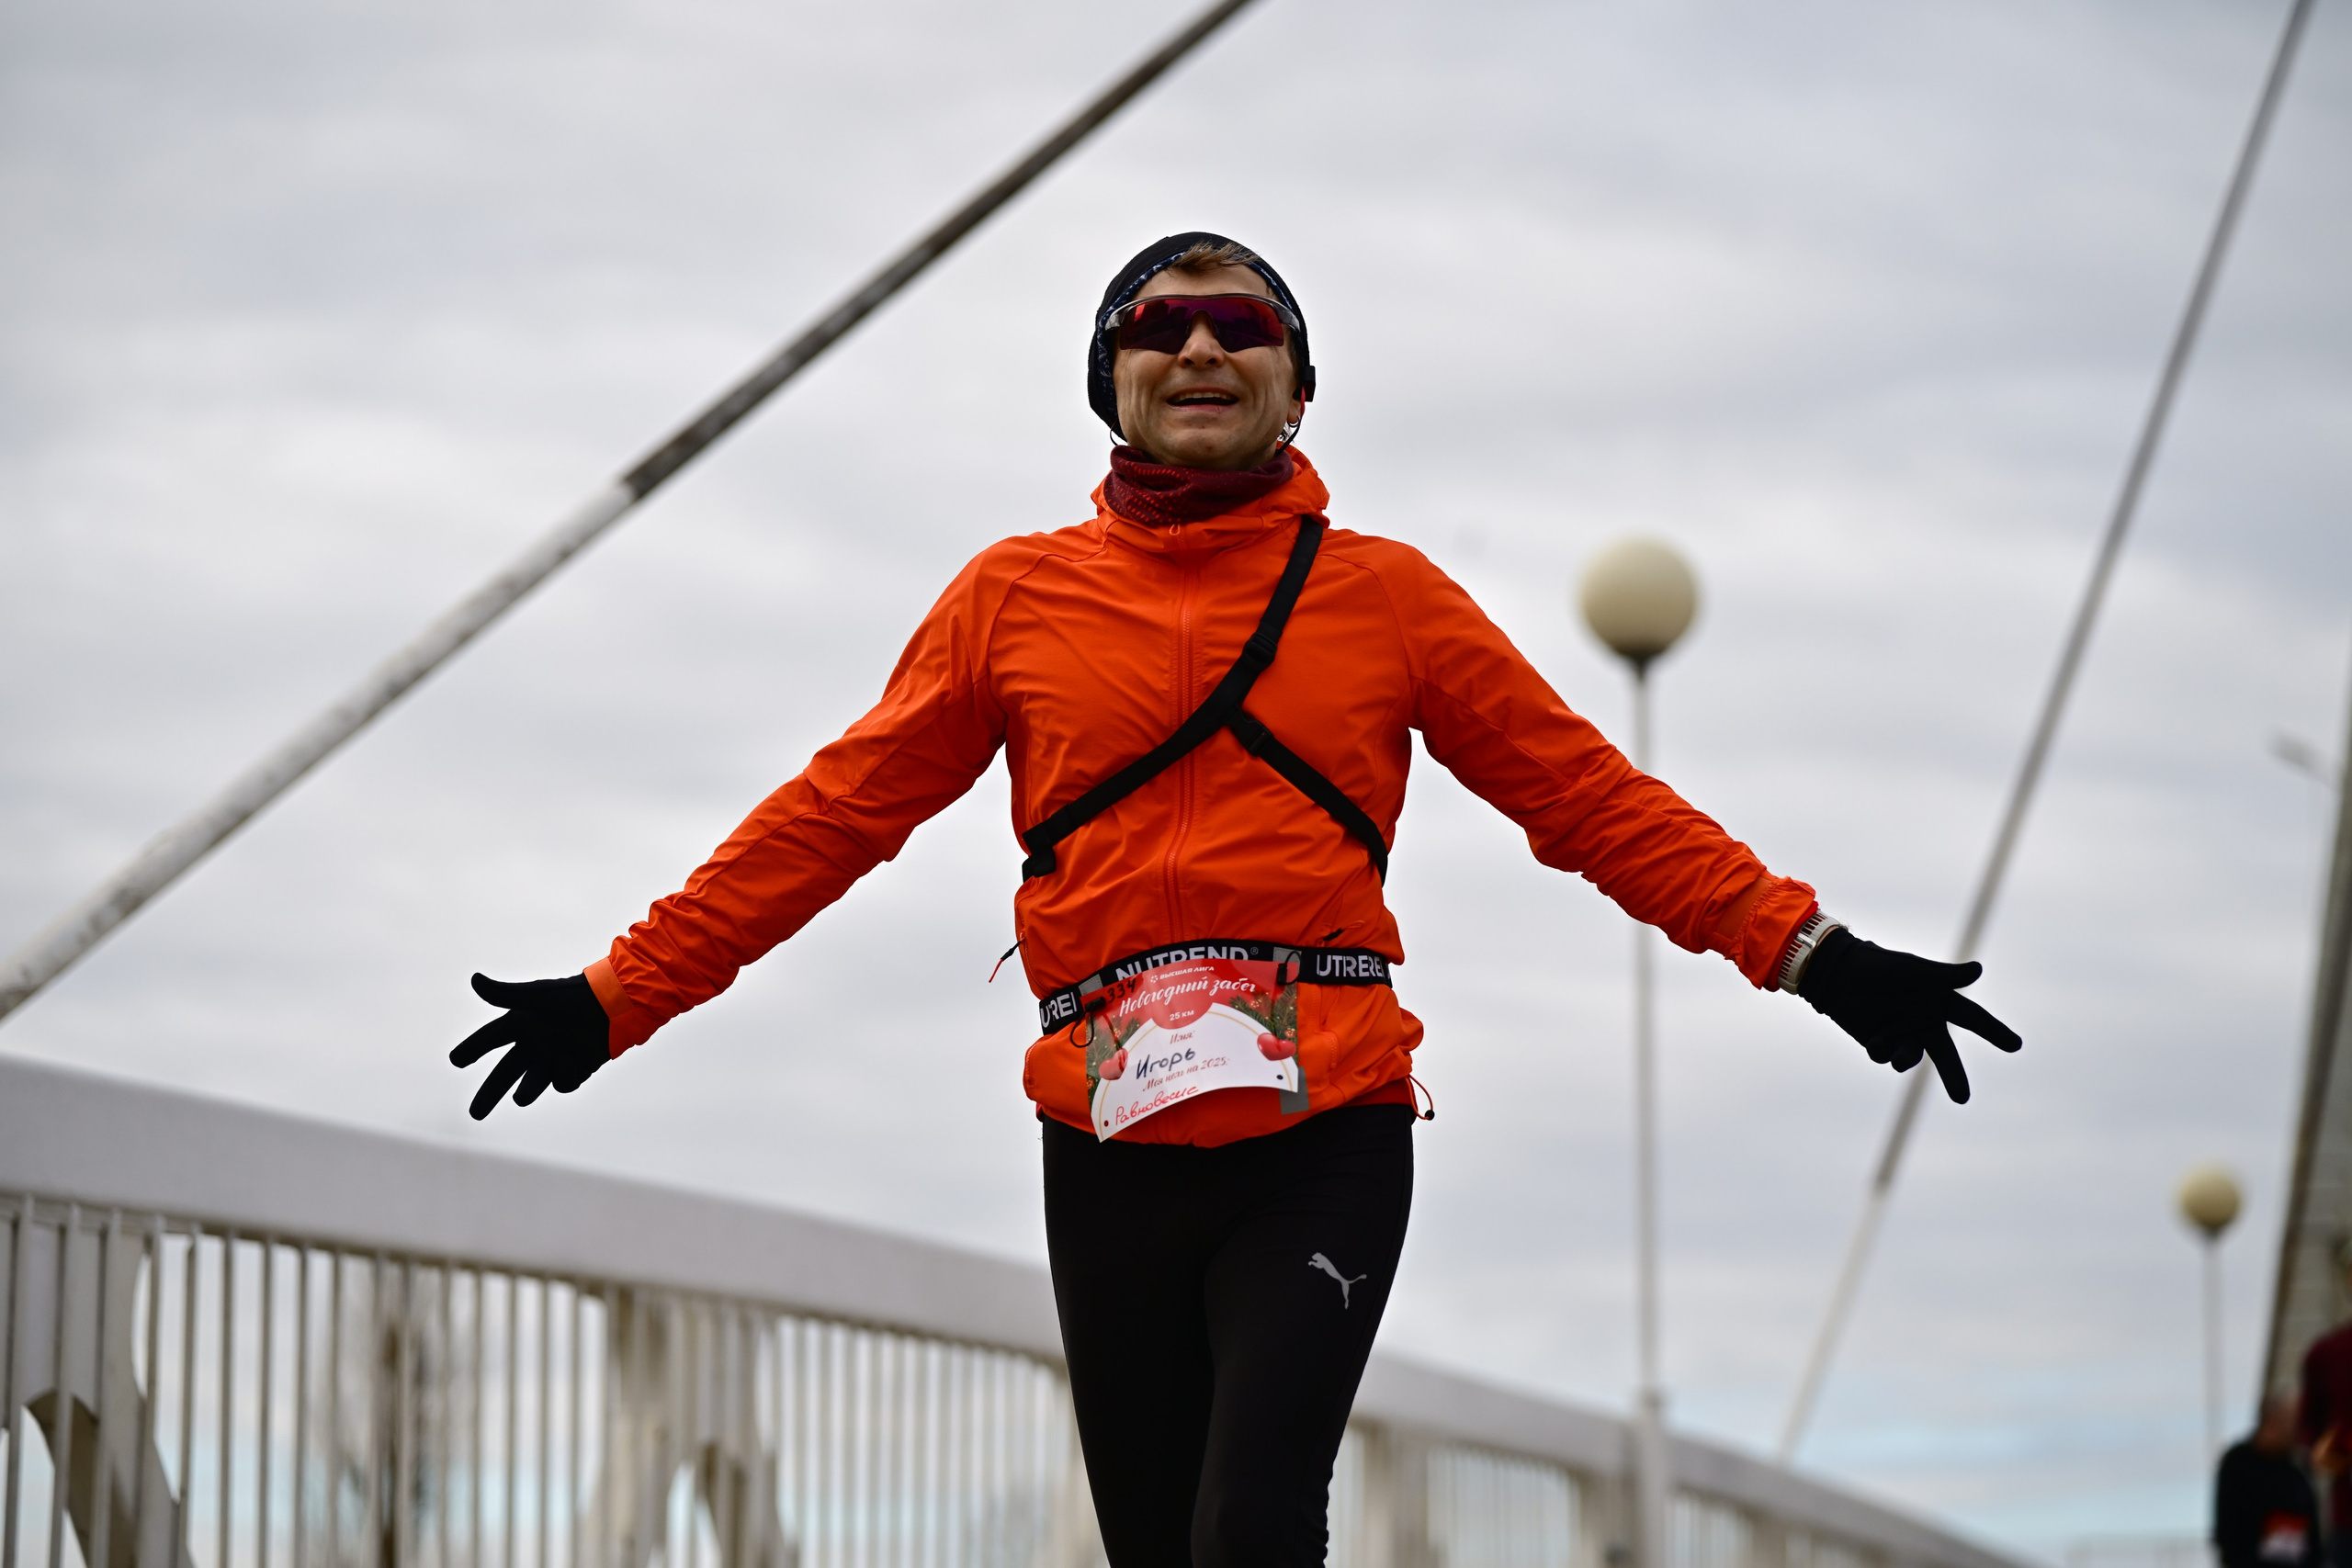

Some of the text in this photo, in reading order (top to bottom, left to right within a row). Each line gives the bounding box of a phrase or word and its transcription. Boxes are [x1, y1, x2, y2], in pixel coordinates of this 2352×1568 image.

[1159, 969, 1193, 979] ВЫСШАЯ
[1119, 976, 1256, 1017] Новогодний забег
[1170, 1012, 1181, 1021] 25
[1136, 1047, 1196, 1080] Игорь
[1186, 1065, 1199, 1074] на
